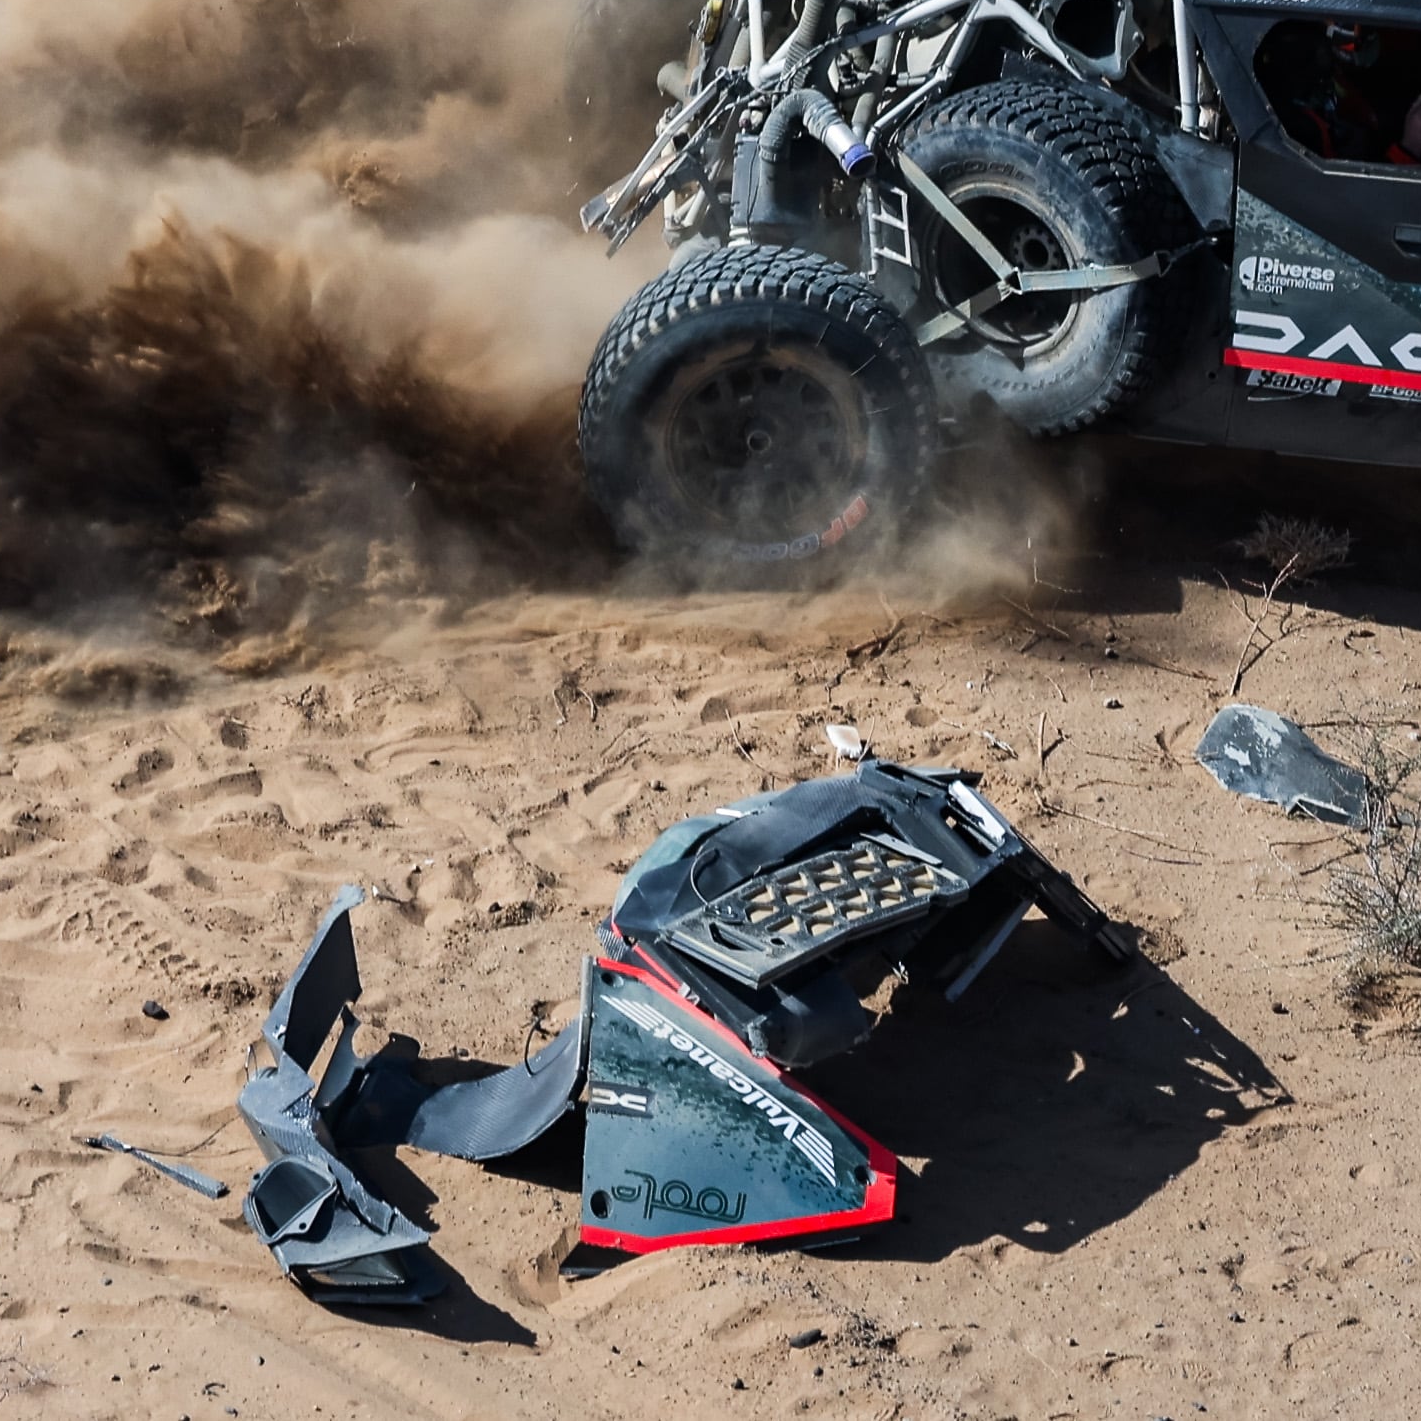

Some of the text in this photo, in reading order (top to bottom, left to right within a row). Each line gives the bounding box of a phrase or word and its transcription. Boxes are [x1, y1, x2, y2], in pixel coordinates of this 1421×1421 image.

[1259, 256, 1336, 281] Diverse
[1255, 282, 1283, 296] .com
[1257, 275, 1334, 292] ExtremeTeam
[653, 1024, 801, 1141] Vulcanet
